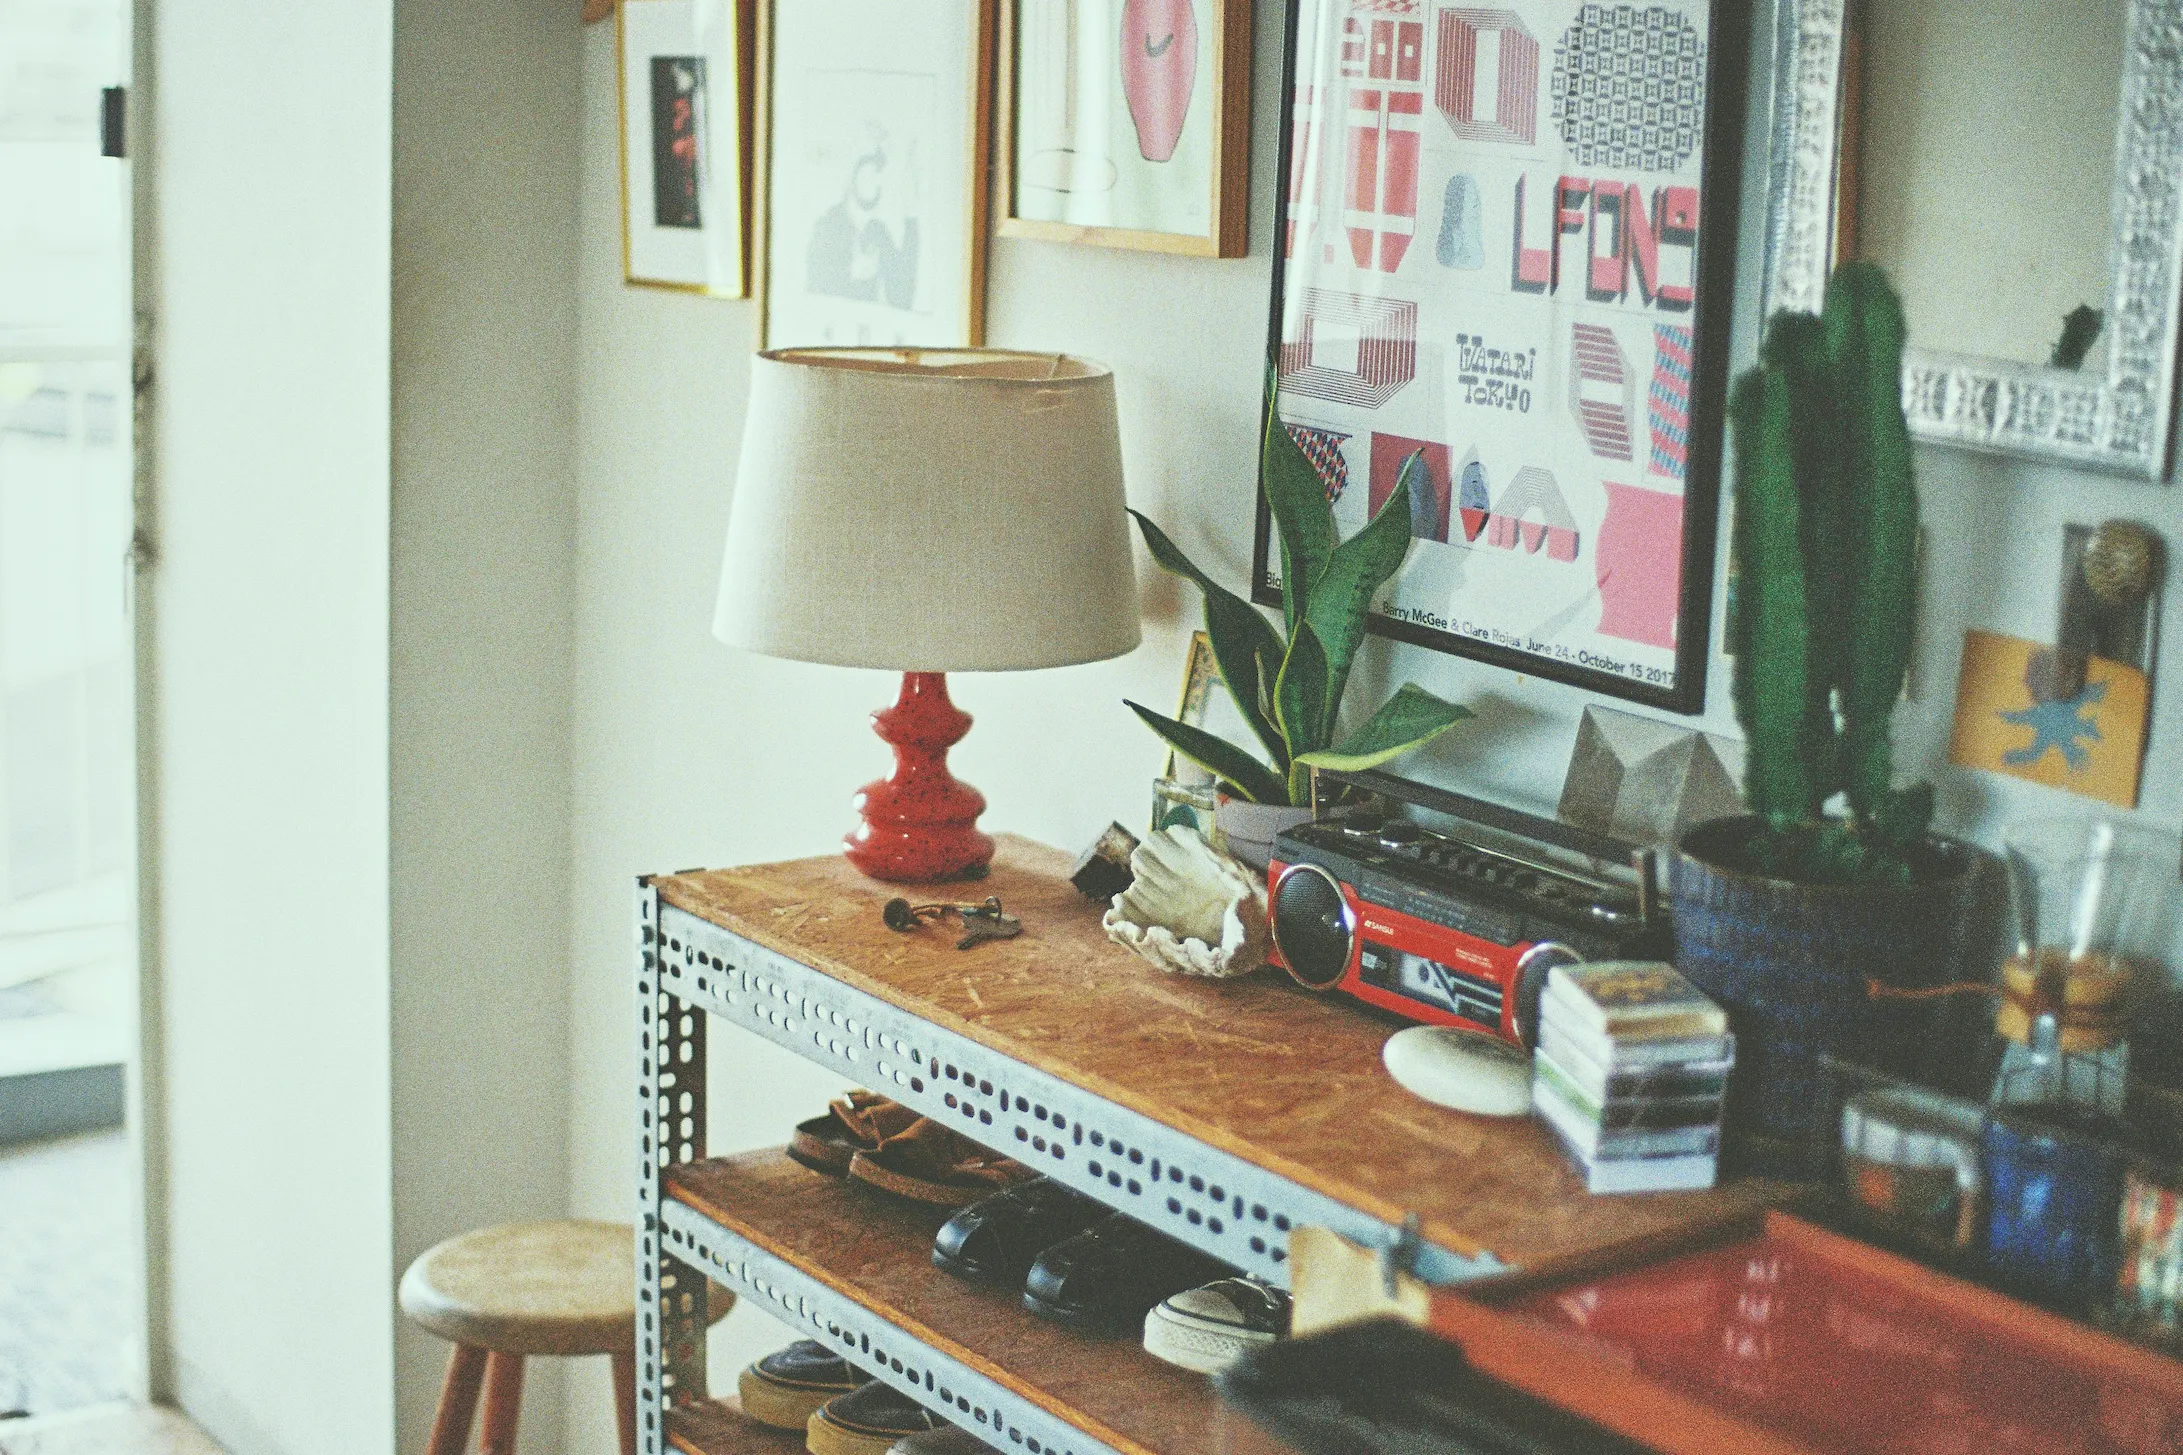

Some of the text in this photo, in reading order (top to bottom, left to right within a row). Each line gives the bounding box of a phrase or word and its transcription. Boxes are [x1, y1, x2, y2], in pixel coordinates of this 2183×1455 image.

[1383, 601, 1409, 621] Barry
[1412, 608, 1447, 629] McGee
[1451, 619, 1459, 632] &
[1463, 621, 1489, 639] Clare
[1492, 628, 1520, 647] Rojas
[1526, 638, 1551, 655] June
[1555, 644, 1569, 660] 24
[1578, 649, 1625, 672] October
[1629, 663, 1643, 678] 15
